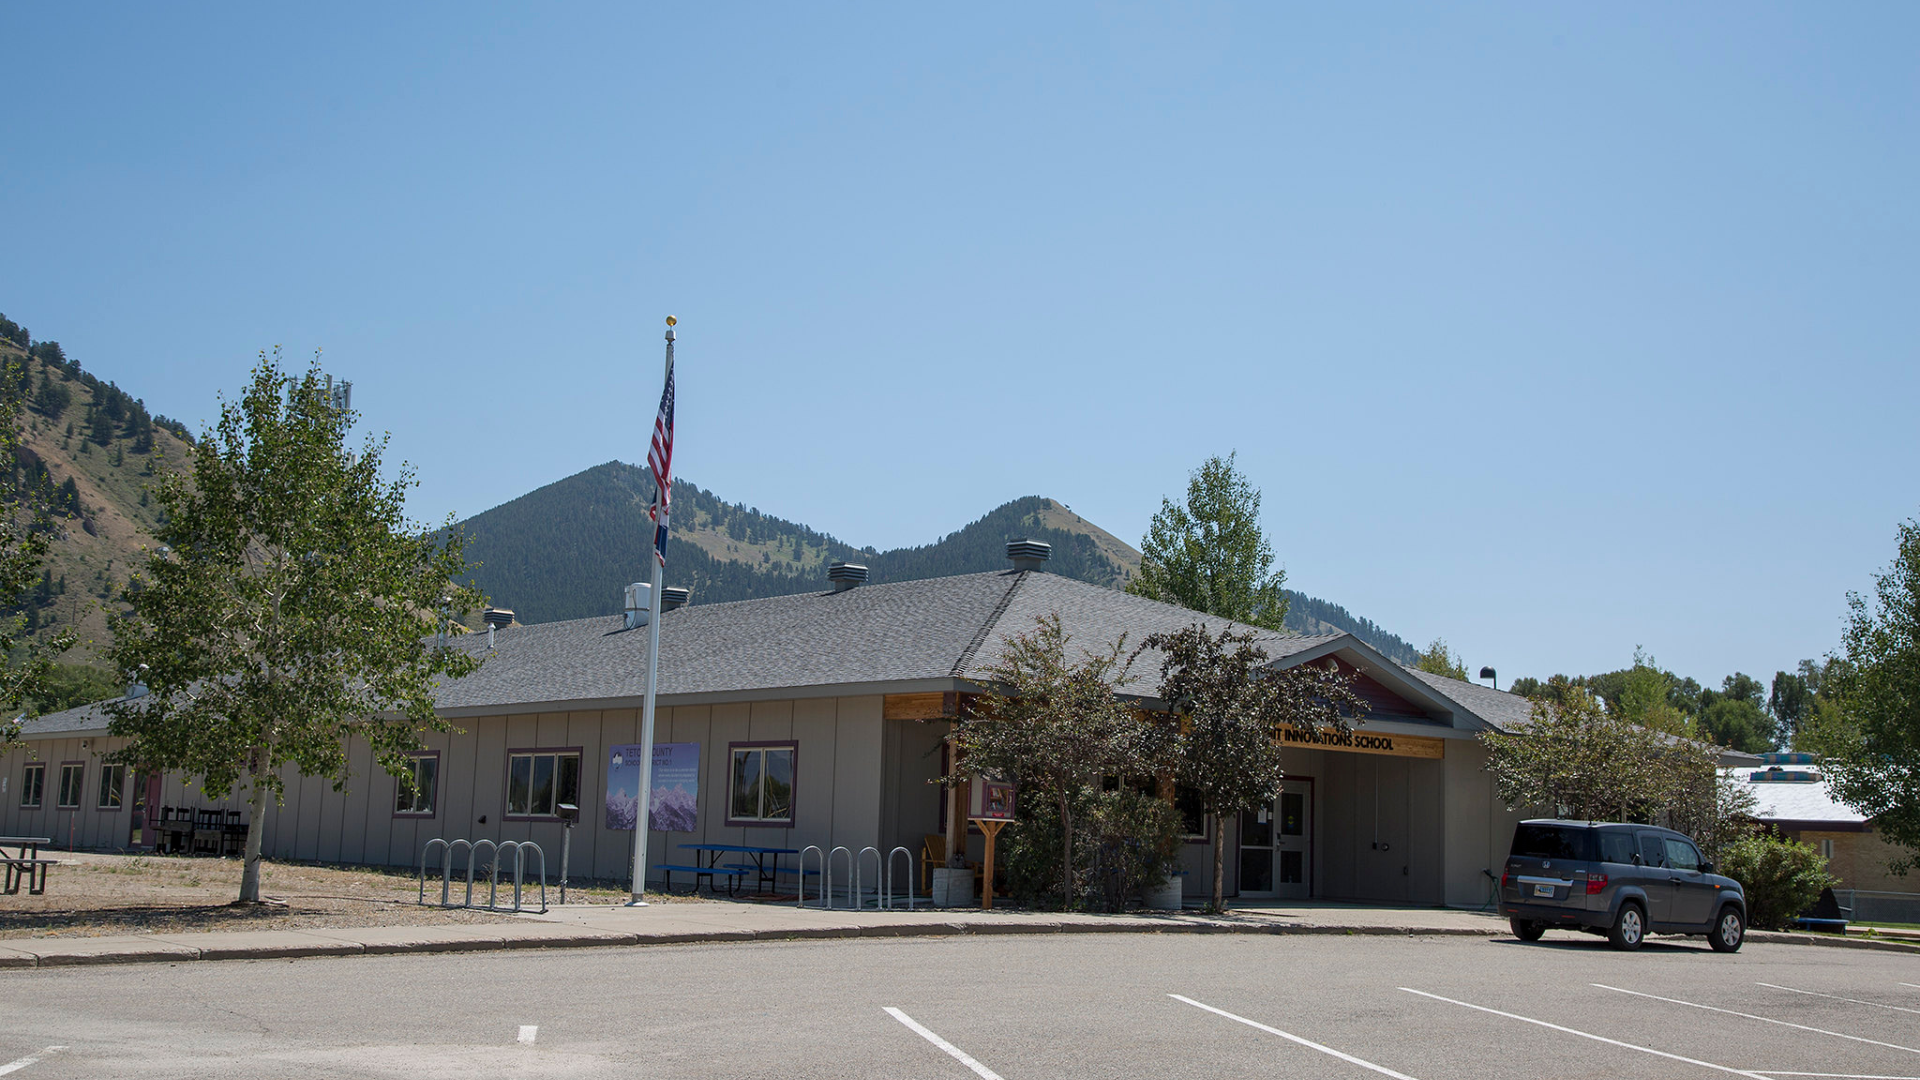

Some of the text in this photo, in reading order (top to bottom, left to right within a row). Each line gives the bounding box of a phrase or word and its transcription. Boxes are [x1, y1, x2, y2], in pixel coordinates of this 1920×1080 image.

[1355, 735, 1394, 750] SCHOOL
[625, 747, 673, 757] TETO OUNTY
